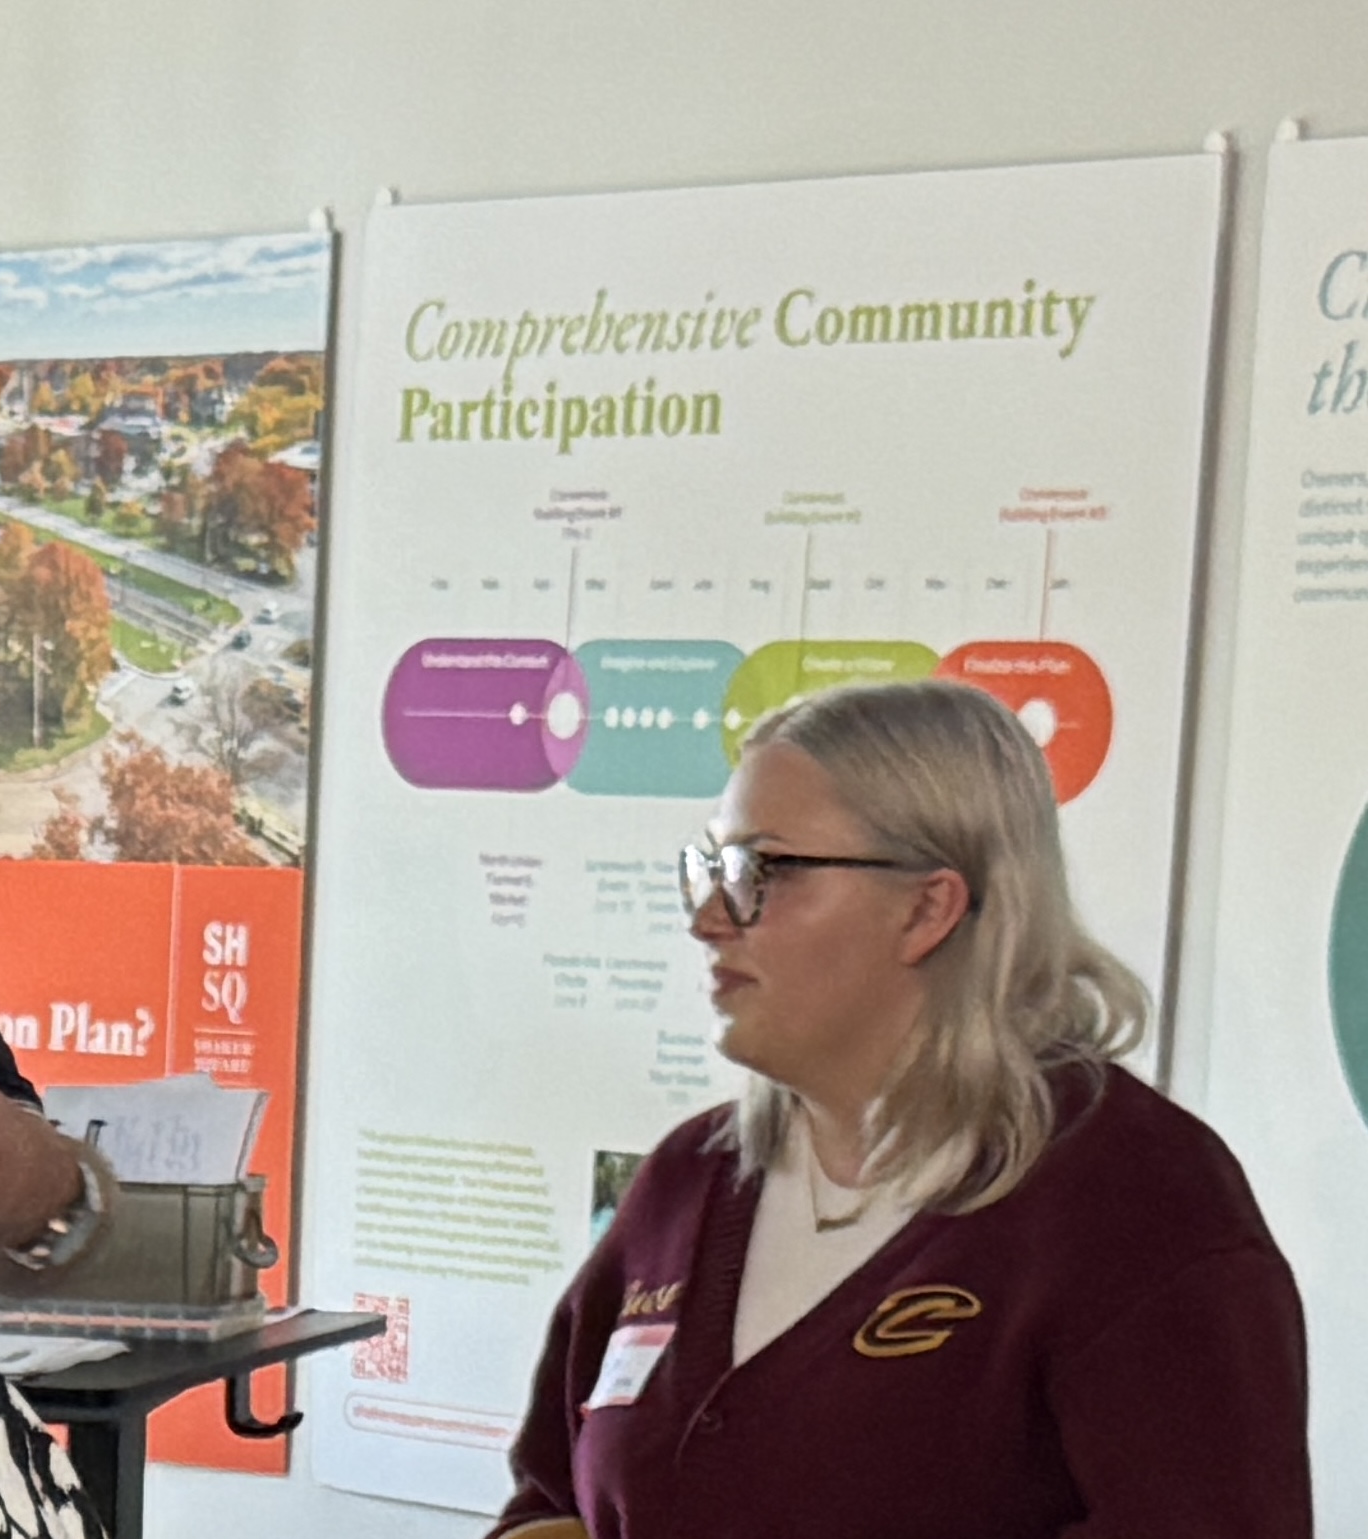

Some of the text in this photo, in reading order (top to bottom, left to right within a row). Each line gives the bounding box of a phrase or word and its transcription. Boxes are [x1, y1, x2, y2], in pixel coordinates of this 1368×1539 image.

[1318, 249, 1368, 321] C
[405, 278, 1095, 384] Comprehensive Community
[1307, 339, 1368, 415] th
[396, 376, 723, 455] Participation
[202, 921, 249, 967] SH
[48, 1001, 156, 1058] Plan?
[201, 969, 248, 1025] SQ
